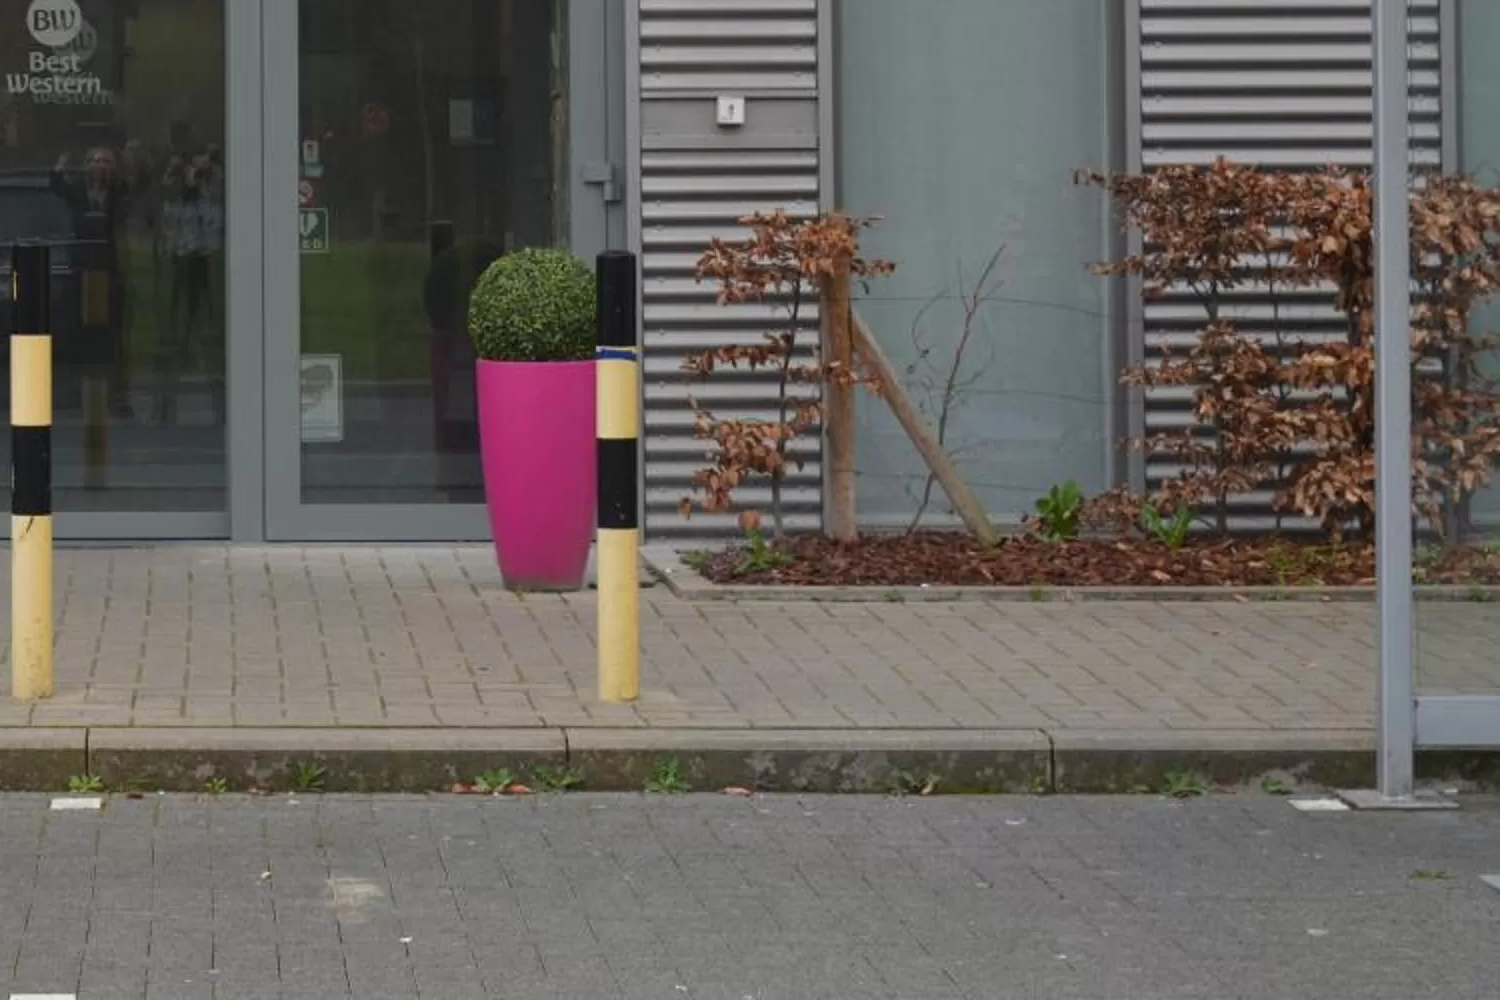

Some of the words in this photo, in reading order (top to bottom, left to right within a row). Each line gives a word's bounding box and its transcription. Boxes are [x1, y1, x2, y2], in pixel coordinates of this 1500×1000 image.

[33, 9, 76, 32] BW
[29, 52, 81, 73] Best
[5, 73, 101, 94] Western
